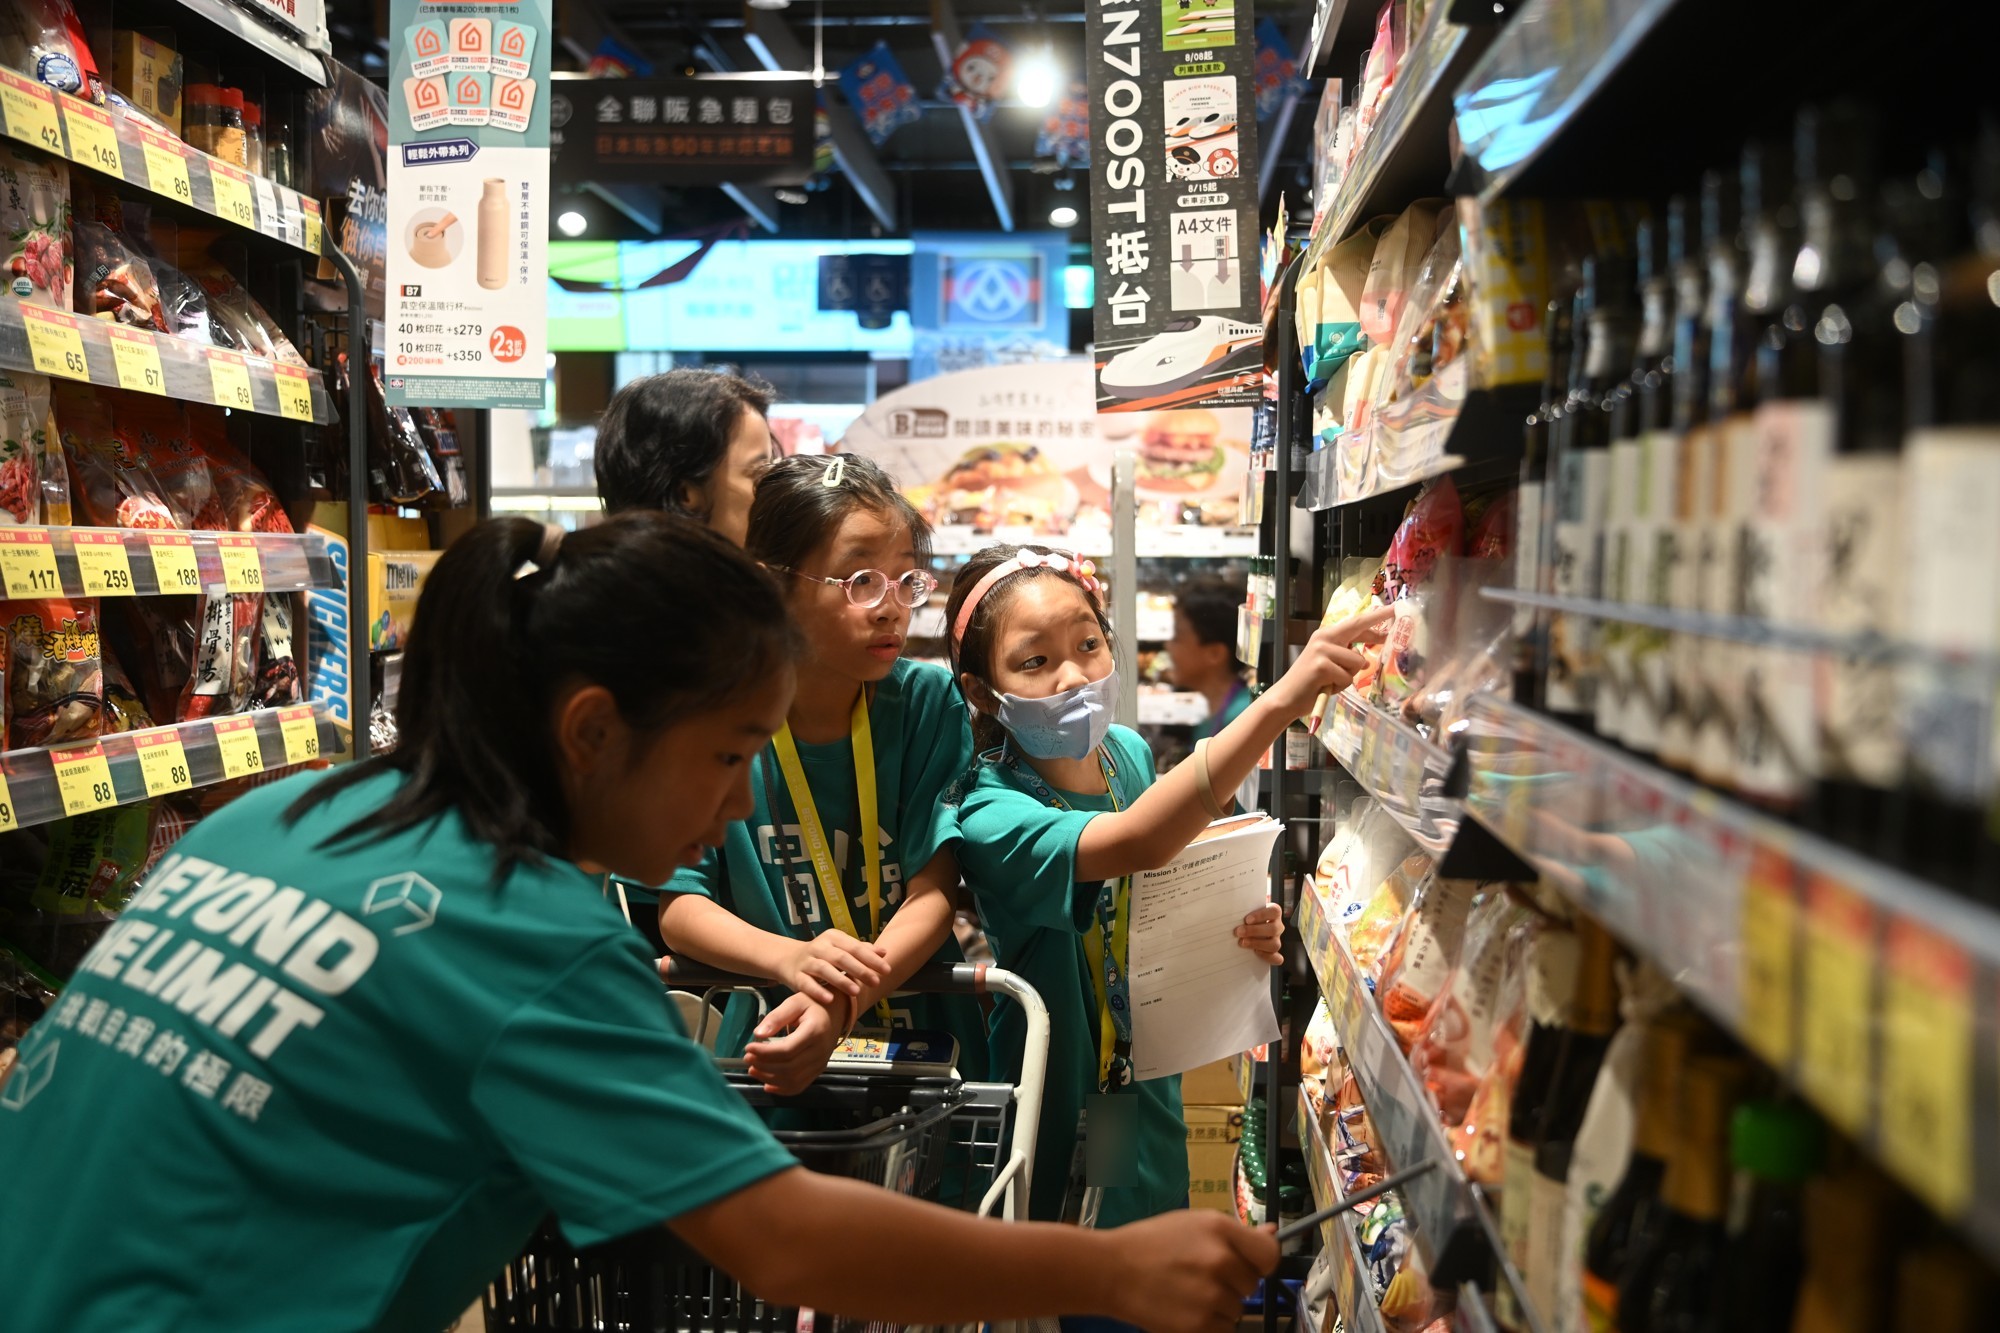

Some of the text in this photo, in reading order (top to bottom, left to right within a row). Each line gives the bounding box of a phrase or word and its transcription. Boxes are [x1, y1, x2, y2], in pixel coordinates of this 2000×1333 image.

[1185, 51, 1213, 62] 8/08起
[597, 95, 794, 124] 全聯阪急麵包
[42, 126, 60, 148] 42
[93, 144, 117, 170] 149
[174, 176, 188, 198] 89
[1187, 182, 1218, 193] 8/15起
[232, 201, 251, 222] 189
[1177, 216, 1232, 235] A4文件
[406, 286, 420, 296] B7
[398, 324, 414, 334] 40
[398, 342, 413, 354] 10
[65, 351, 84, 373] 65
[144, 368, 159, 387] 67
[236, 386, 250, 404] 69
[294, 397, 310, 415] 156
[29, 570, 55, 590] 117
[104, 570, 129, 588] 259
[176, 568, 198, 586] 188
[242, 568, 260, 585] 168
[198, 599, 222, 683] 排骨湯
[305, 738, 317, 754] 86
[246, 750, 259, 768] 86
[171, 765, 187, 784] 88
[93, 781, 112, 803] 88
[802, 808, 839, 903] BEYOND THE LIMIT
[1143, 869, 1172, 879] Mission
[122, 928, 326, 1061] LIMIT
